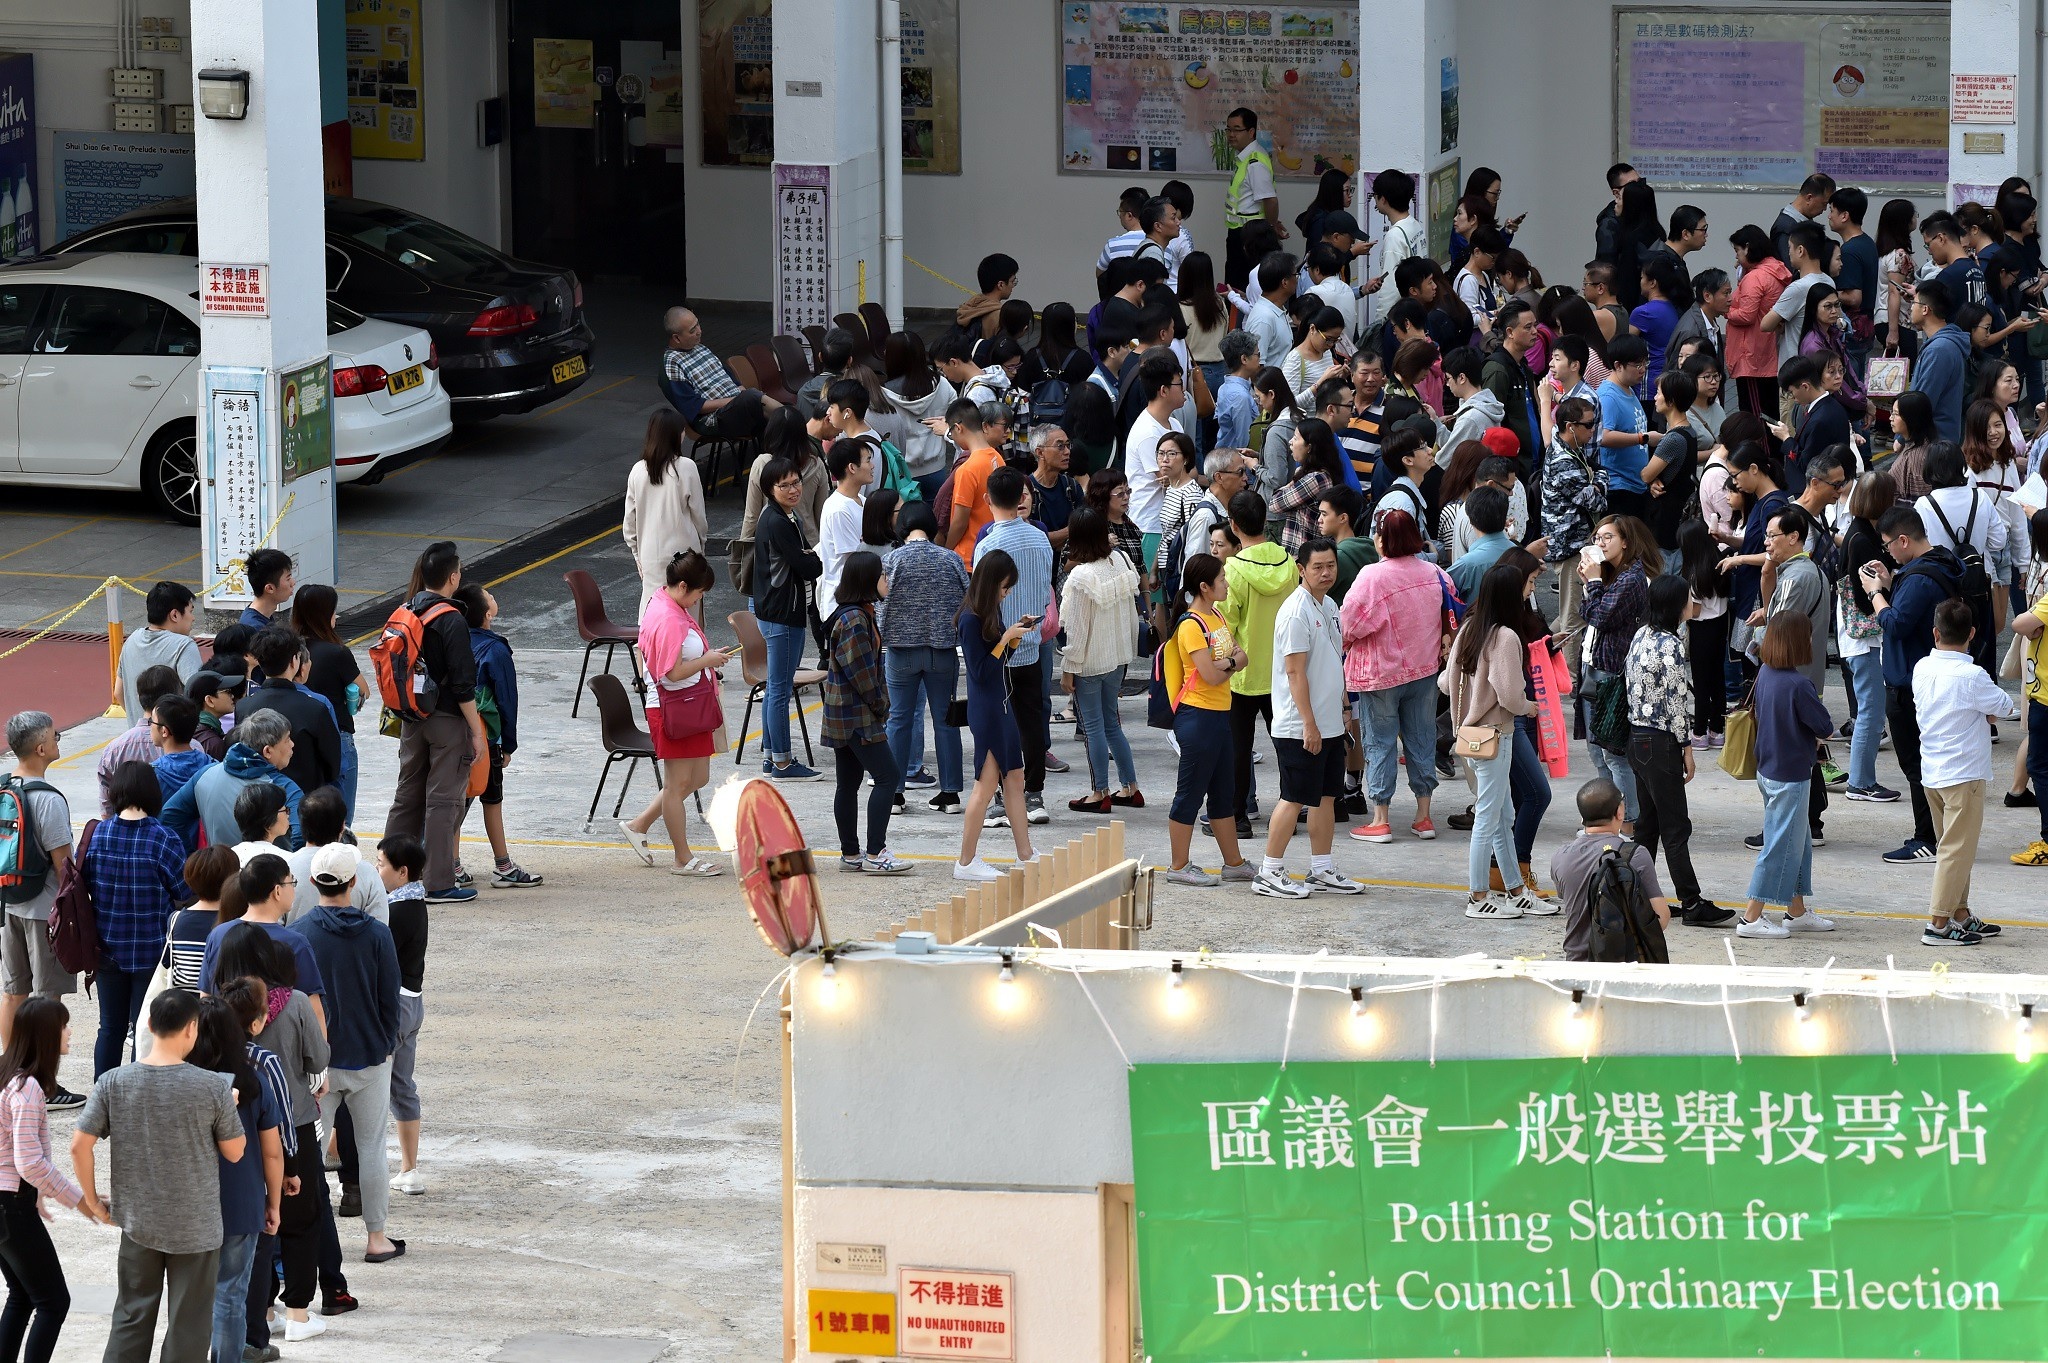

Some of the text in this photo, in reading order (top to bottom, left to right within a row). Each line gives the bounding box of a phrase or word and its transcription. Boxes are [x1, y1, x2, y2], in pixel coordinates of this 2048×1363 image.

[1178, 8, 1272, 36] 廣東童謠
[113, 144, 126, 152] Tou
[129, 145, 156, 154] (Prelude
[209, 267, 259, 281] 不得擅用
[209, 280, 260, 294] 本校設施
[213, 295, 254, 303] UNAUTHORIZED
[255, 296, 265, 304] USE
[222, 398, 250, 412] 論語
[1201, 1089, 1989, 1171] 區議會一般選舉投票站
[1387, 1198, 1810, 1252] Polling Station for
[908, 1279, 1005, 1308] 不得擅進
[1211, 1266, 2004, 1322] District Council Ordinary Election
[907, 1316, 1005, 1334] NO UNAUTHORIZED
[940, 1336, 973, 1350] ENTRY
